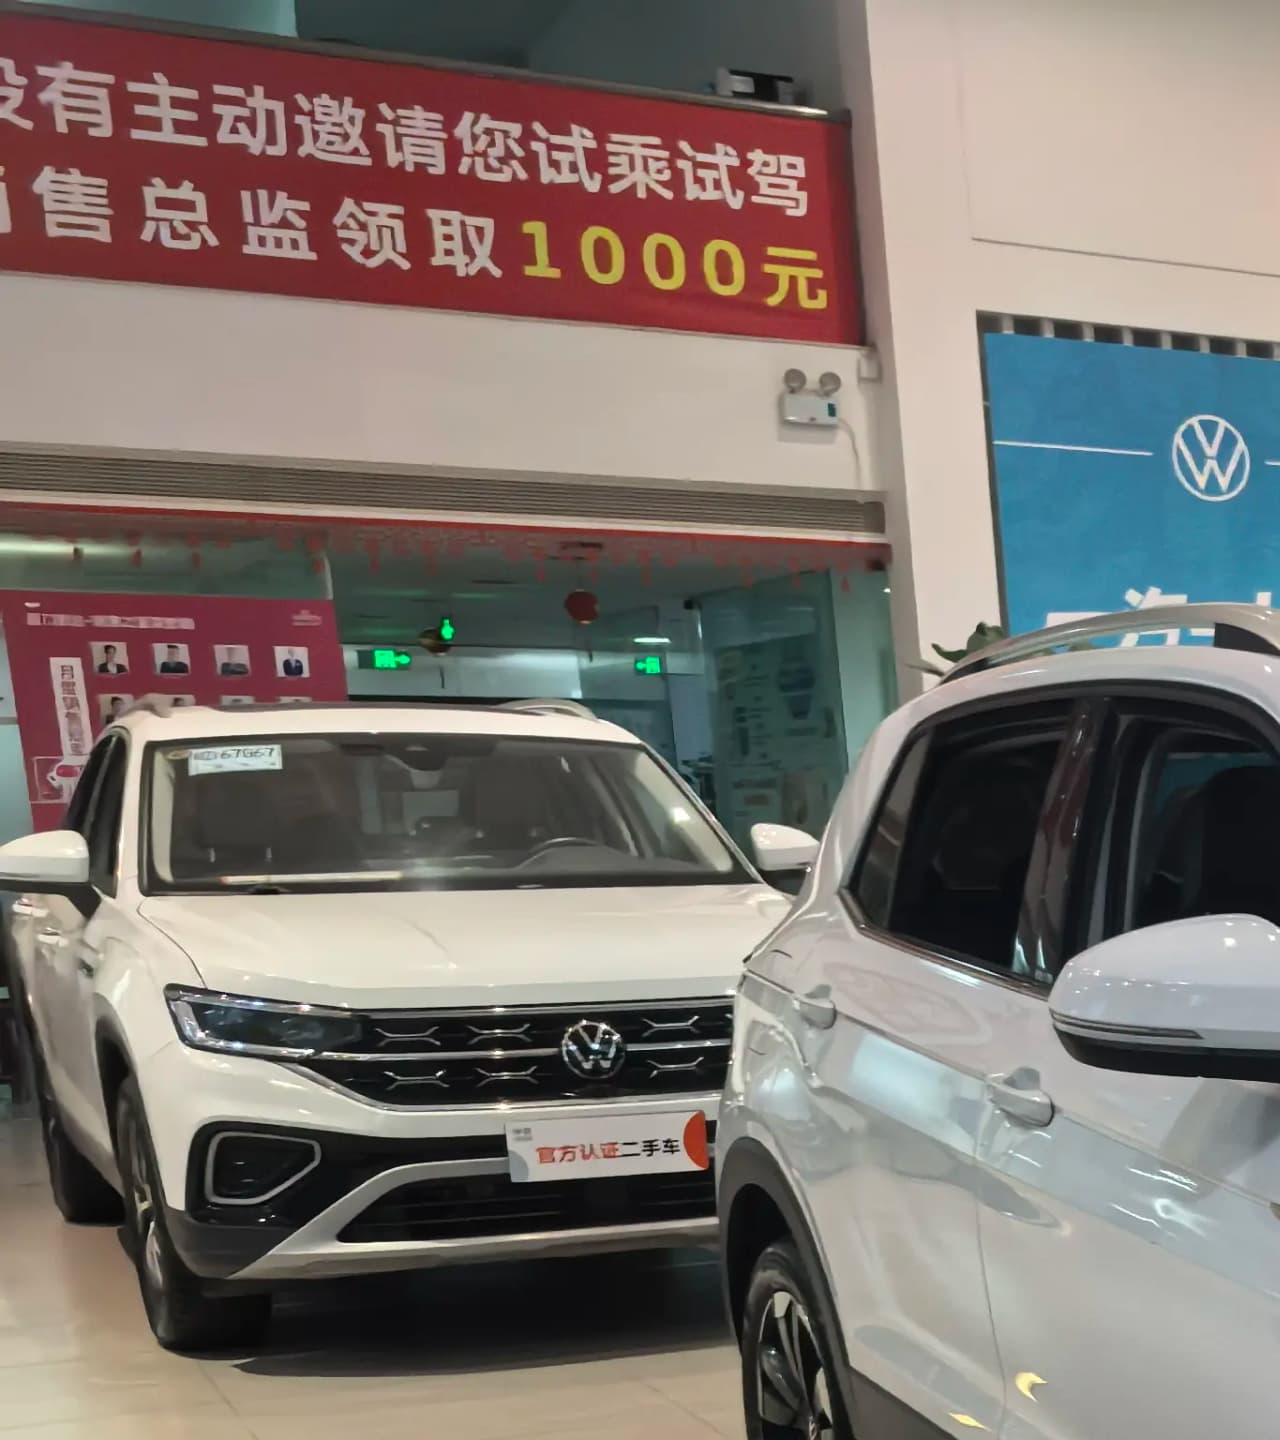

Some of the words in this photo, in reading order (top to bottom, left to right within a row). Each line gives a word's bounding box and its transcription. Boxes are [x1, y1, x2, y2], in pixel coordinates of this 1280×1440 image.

[0, 165, 828, 310] 售总监领取1000元
[536, 1138, 681, 1164] 官方认证二手车
